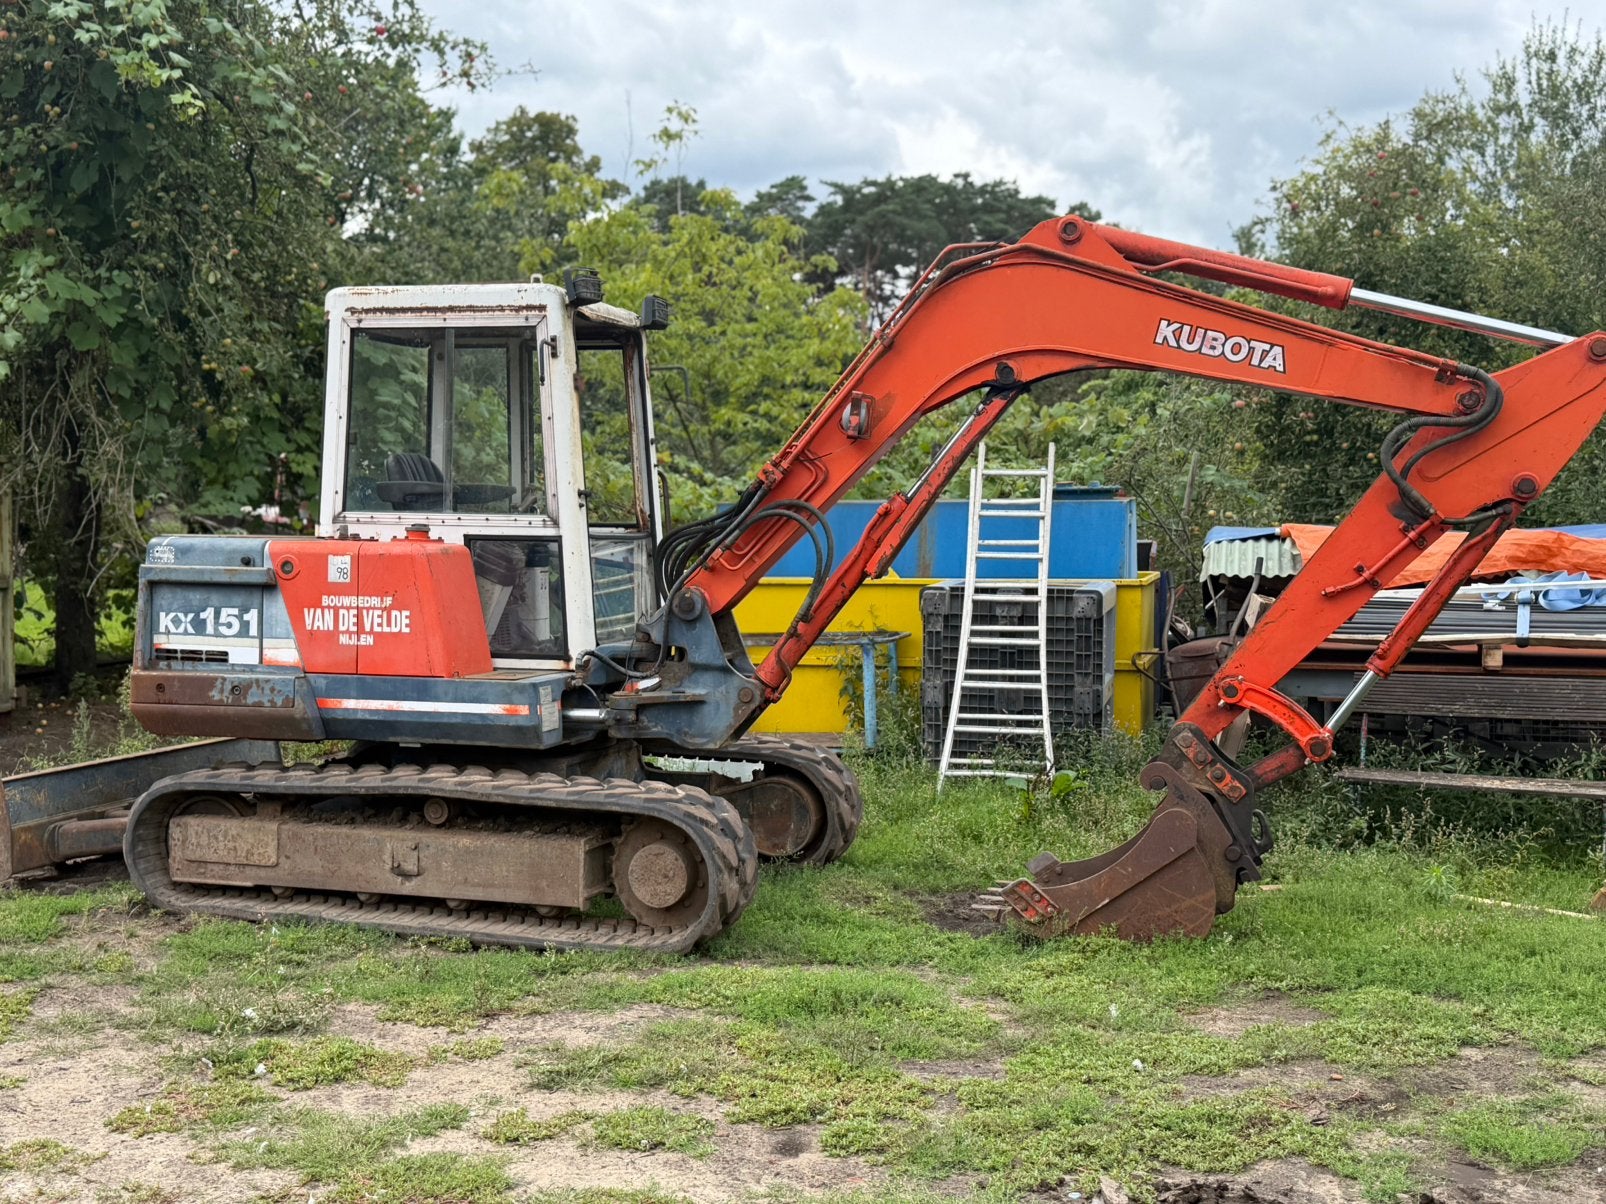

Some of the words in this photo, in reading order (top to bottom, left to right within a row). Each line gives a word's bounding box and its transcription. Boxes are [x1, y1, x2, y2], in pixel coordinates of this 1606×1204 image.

[1153, 318, 1287, 374] KUBOTA
[336, 566, 349, 580] 98
[321, 595, 393, 608] BOUWBEDRIJF
[303, 607, 334, 631] VAN
[338, 608, 358, 632] DE
[362, 609, 411, 633] VELDE
[339, 633, 374, 645] NIJLEN
